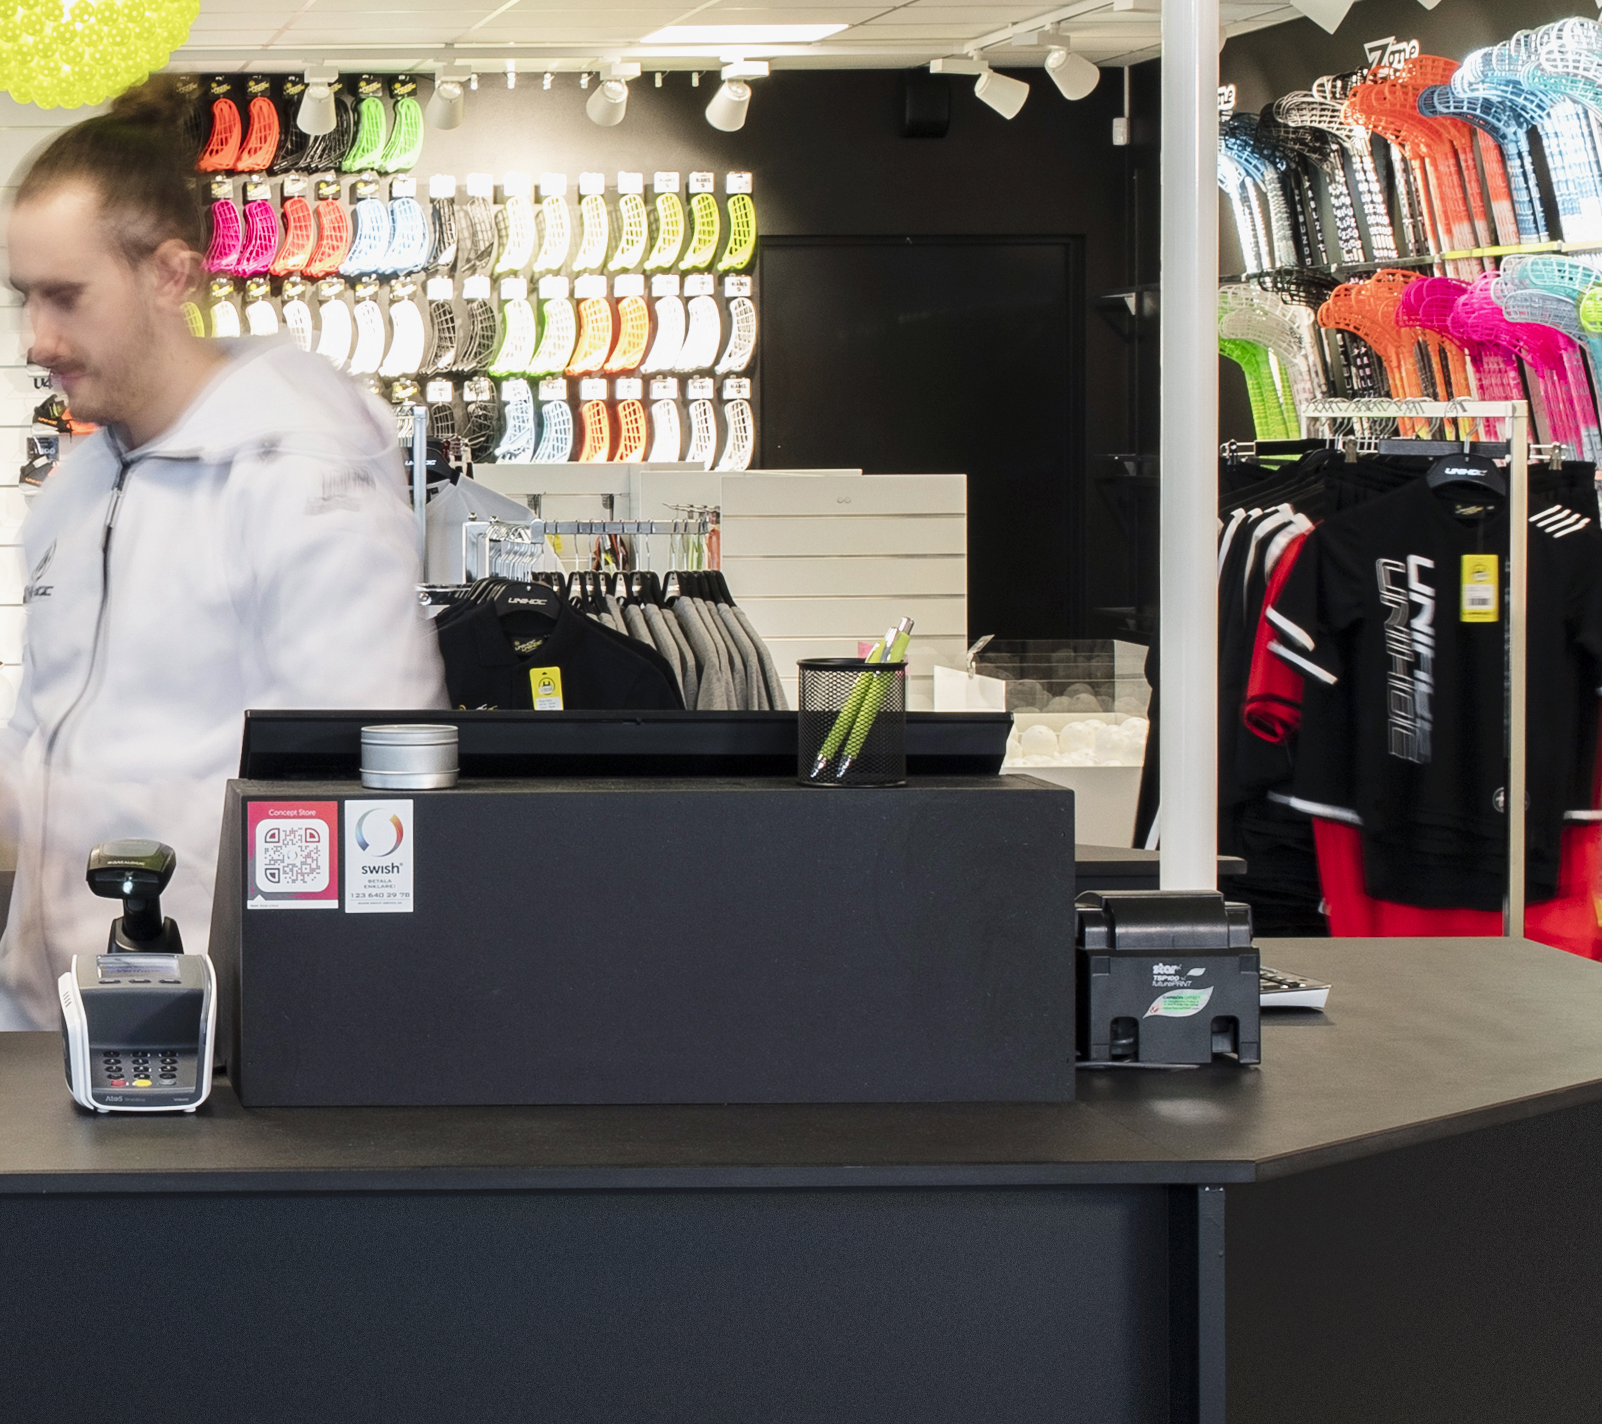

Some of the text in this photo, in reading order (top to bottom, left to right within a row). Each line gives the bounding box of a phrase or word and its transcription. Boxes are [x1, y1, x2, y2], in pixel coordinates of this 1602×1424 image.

[508, 597, 547, 605] UNIHOC
[269, 809, 297, 817] Concept
[1152, 963, 1178, 975] star
